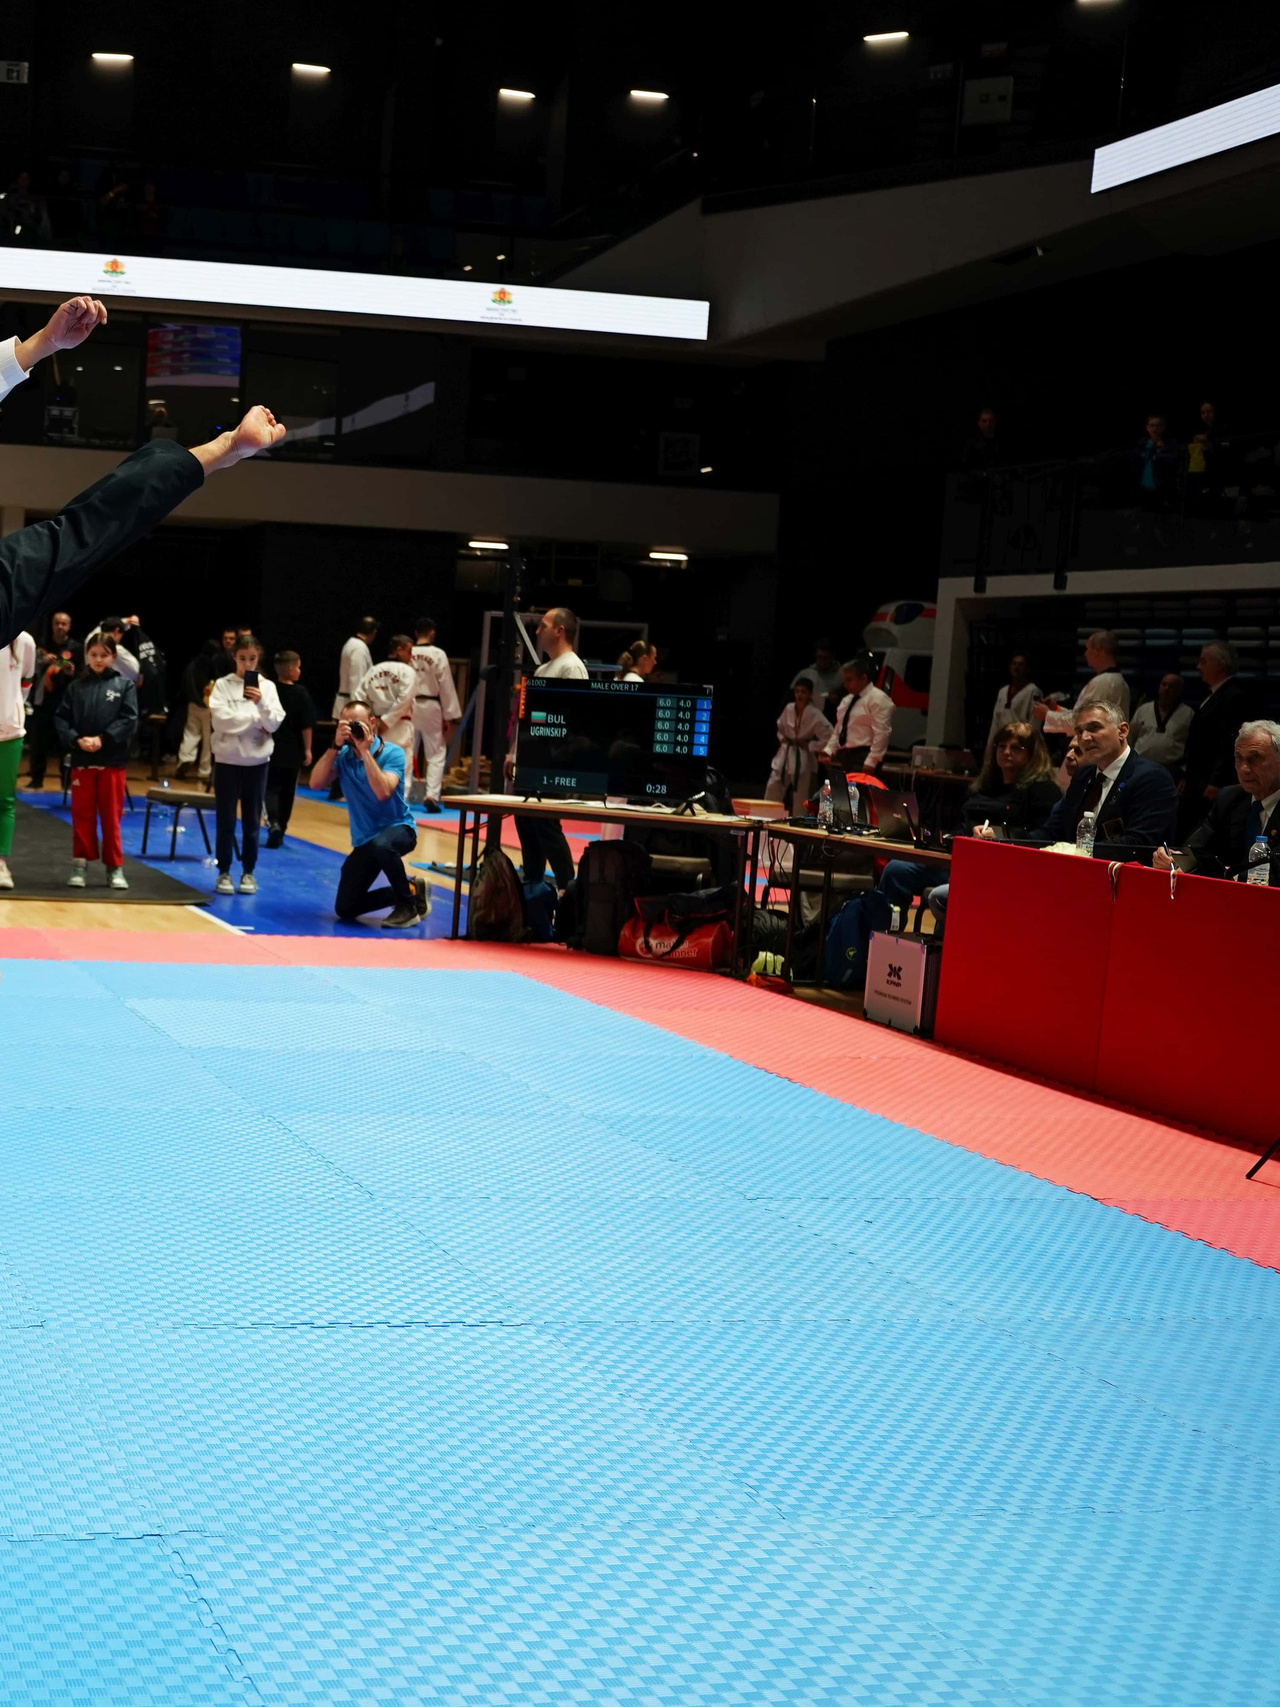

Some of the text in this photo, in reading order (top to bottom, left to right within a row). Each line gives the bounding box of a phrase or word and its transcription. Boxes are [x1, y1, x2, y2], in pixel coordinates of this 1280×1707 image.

[591, 682, 609, 690] MALE
[659, 699, 672, 707] 6.0
[679, 700, 692, 708] 4.0
[547, 714, 566, 724] BUL
[658, 710, 671, 718] 6.0
[678, 711, 691, 719] 4.0
[530, 726, 567, 738] UGRINSKI P
[677, 723, 690, 731] 4.0
[701, 724, 706, 732] 3
[656, 733, 669, 741] 6.0
[676, 734, 689, 742] 4.0
[675, 746, 688, 754] 4.0
[542, 776, 548, 785] 1
[554, 776, 577, 787] FREE
[646, 784, 667, 794] 0:28
[886, 979, 902, 988] KPNP
